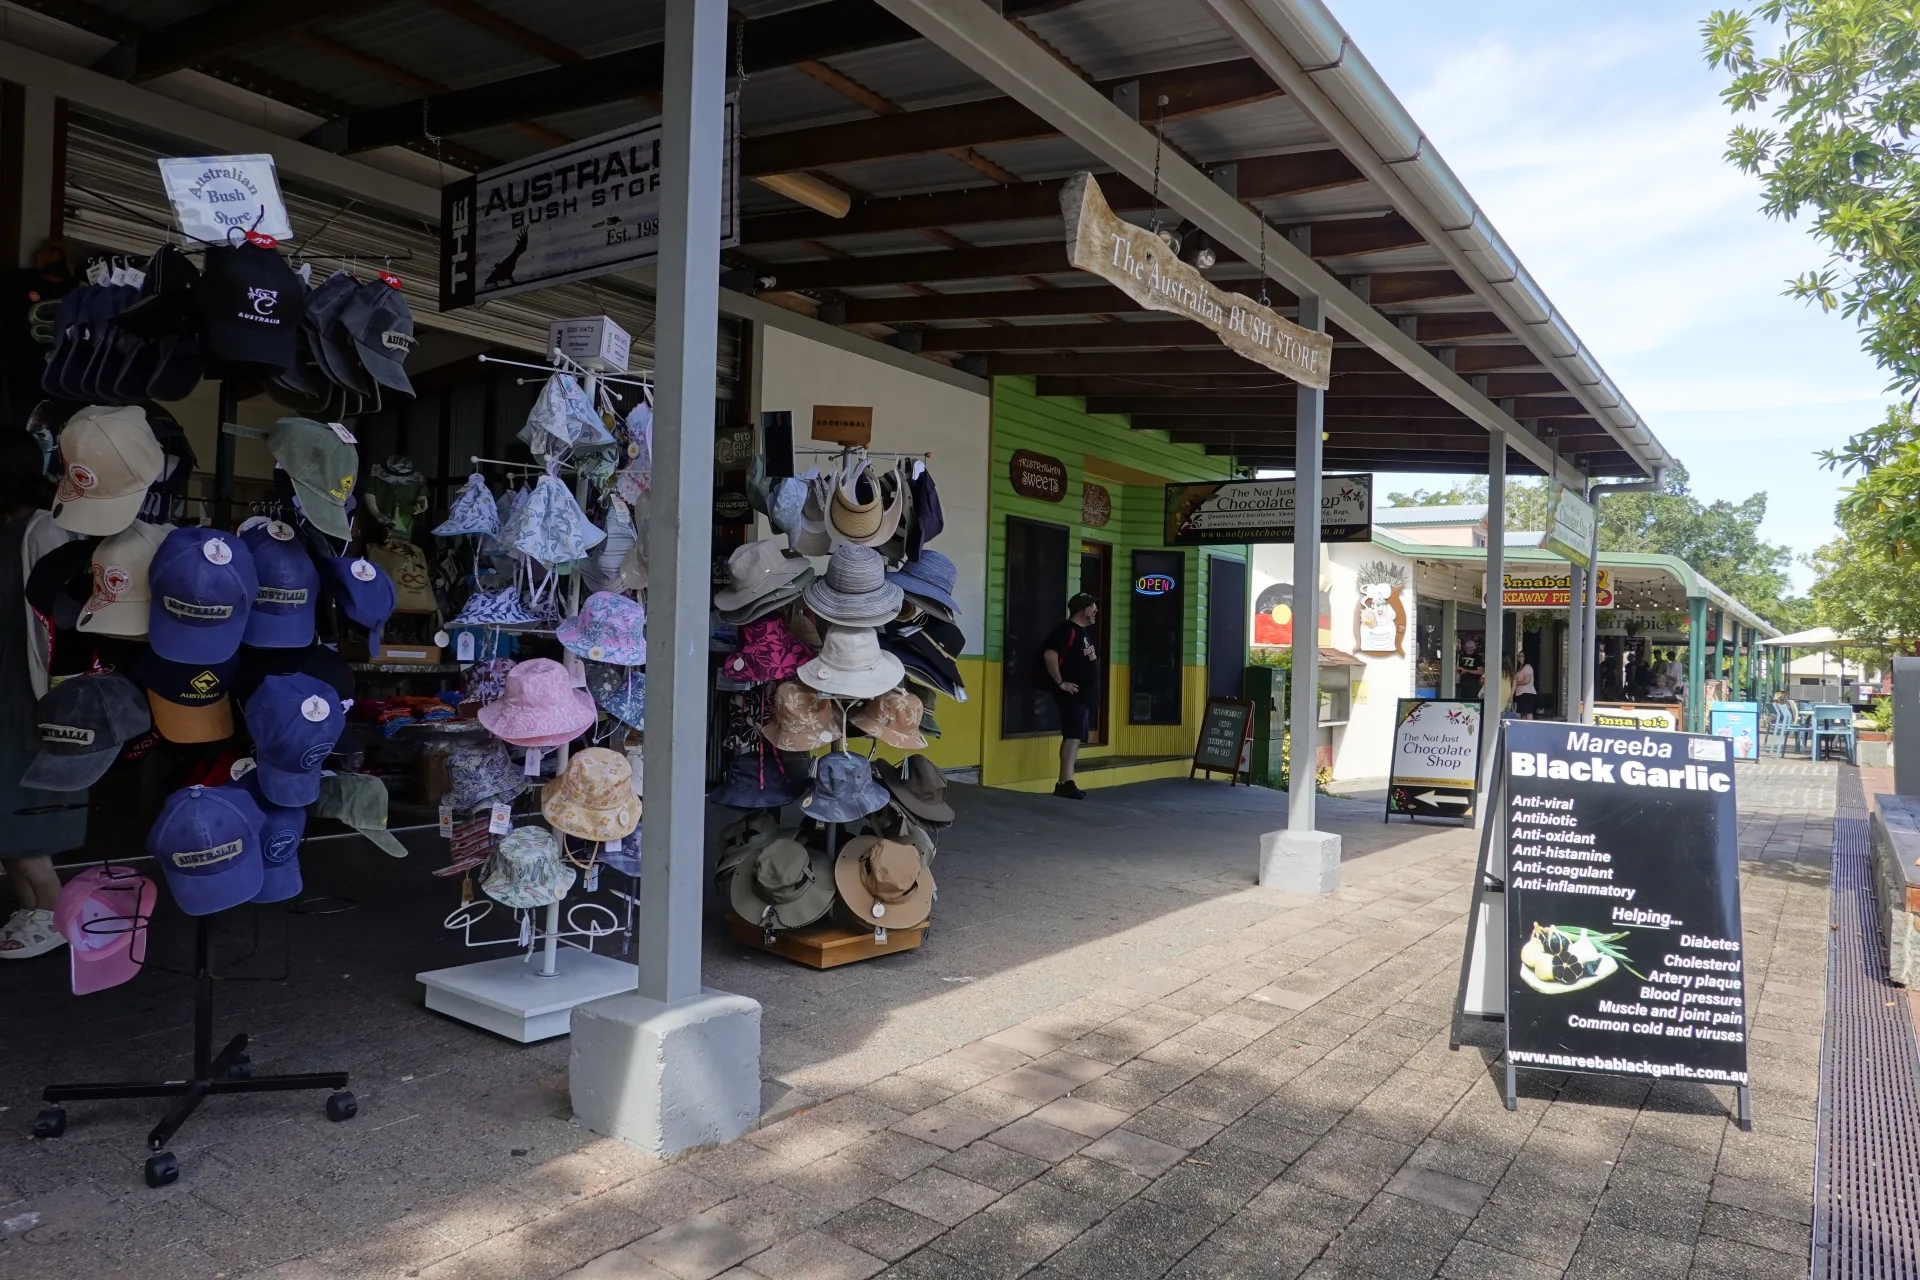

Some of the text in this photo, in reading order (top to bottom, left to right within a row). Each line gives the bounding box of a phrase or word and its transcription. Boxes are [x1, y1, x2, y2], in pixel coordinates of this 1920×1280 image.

[188, 166, 258, 201] Australian
[484, 138, 660, 218] AUSTRALI
[206, 188, 246, 204] Bush
[511, 173, 661, 229] BUSH STOR
[214, 210, 252, 226] Store
[606, 218, 660, 246] Est. 198
[1111, 232, 1318, 374] The Australian BUSH STORE
[238, 312, 280, 325] AUSTRALIA
[1018, 457, 1061, 476] AUSTRALIAN
[1021, 471, 1059, 493] SWEETS
[1231, 487, 1296, 498] The Not Just
[1216, 496, 1294, 511] Chocolate
[1138, 577, 1170, 592] OPEN
[1502, 574, 1572, 589] Annabel
[1503, 592, 1549, 603] KEAWAY
[168, 598, 228, 617] AUSTRALIA
[1403, 732, 1459, 744] The Not Just
[1567, 731, 1673, 759] Mareeba
[1403, 742, 1472, 757] Chocolate
[1426, 755, 1461, 770] Shop
[1511, 752, 1731, 793] Black Garlic
[1512, 795, 1574, 811] Anti-viral
[1512, 811, 1578, 827] Antibiotic
[1512, 827, 1596, 845] Anti-oxidant
[179, 843, 238, 866] AUSTRALIA
[1512, 844, 1612, 863] Anti-histamine
[1512, 860, 1614, 880] Anti-coagulant
[1512, 877, 1636, 901] Anti-inflammatory
[1612, 907, 1683, 927] Helping...
[1680, 934, 1740, 951] Diabetes
[1664, 954, 1741, 973] Cholesterol
[1648, 970, 1742, 990] Artery plaque
[1640, 986, 1742, 1007] Blood pressure
[1599, 1000, 1743, 1025] Muscle and joint pain
[1568, 1014, 1744, 1042] Common cold and viruses
[1508, 1050, 1748, 1083] www.mareebablackgarlic.com.au
